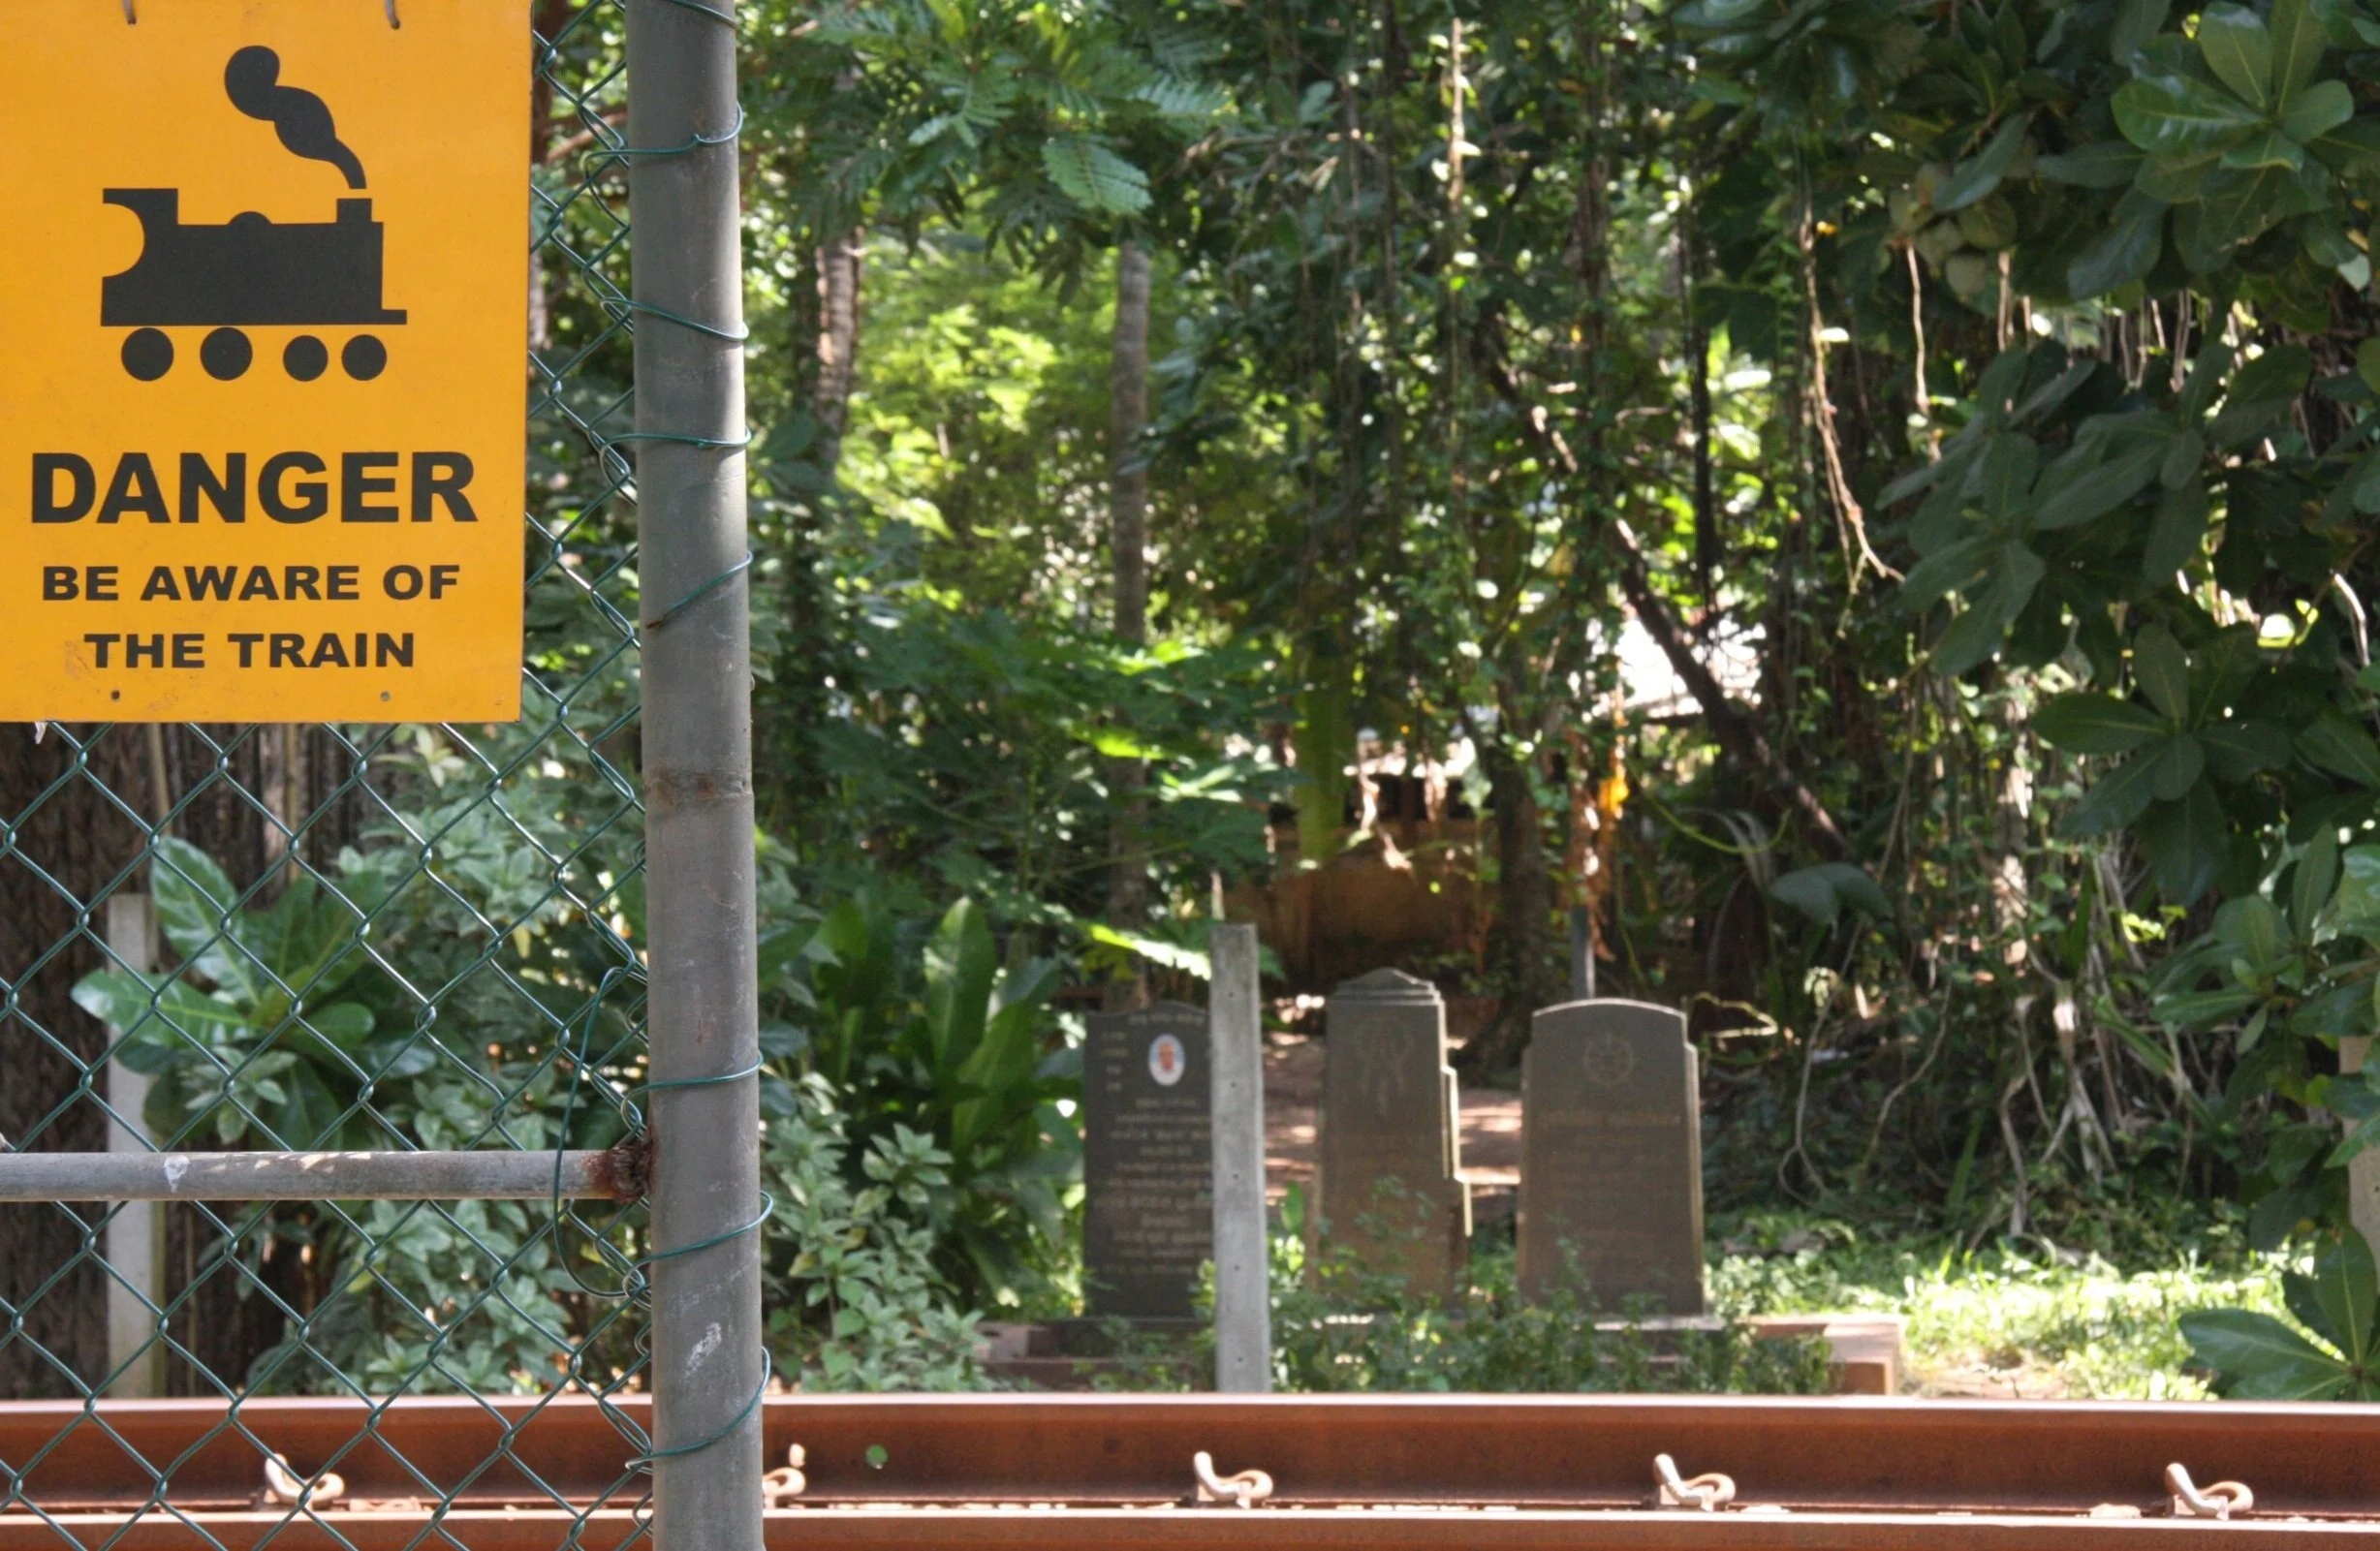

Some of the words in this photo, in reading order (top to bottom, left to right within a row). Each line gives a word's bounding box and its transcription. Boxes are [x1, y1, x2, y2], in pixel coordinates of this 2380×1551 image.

[32, 451, 478, 524] DANGER
[43, 566, 118, 601] BE
[141, 565, 360, 601] AWARE
[383, 564, 460, 600] OF
[83, 633, 205, 668] THE
[228, 633, 414, 668] TRAIN
